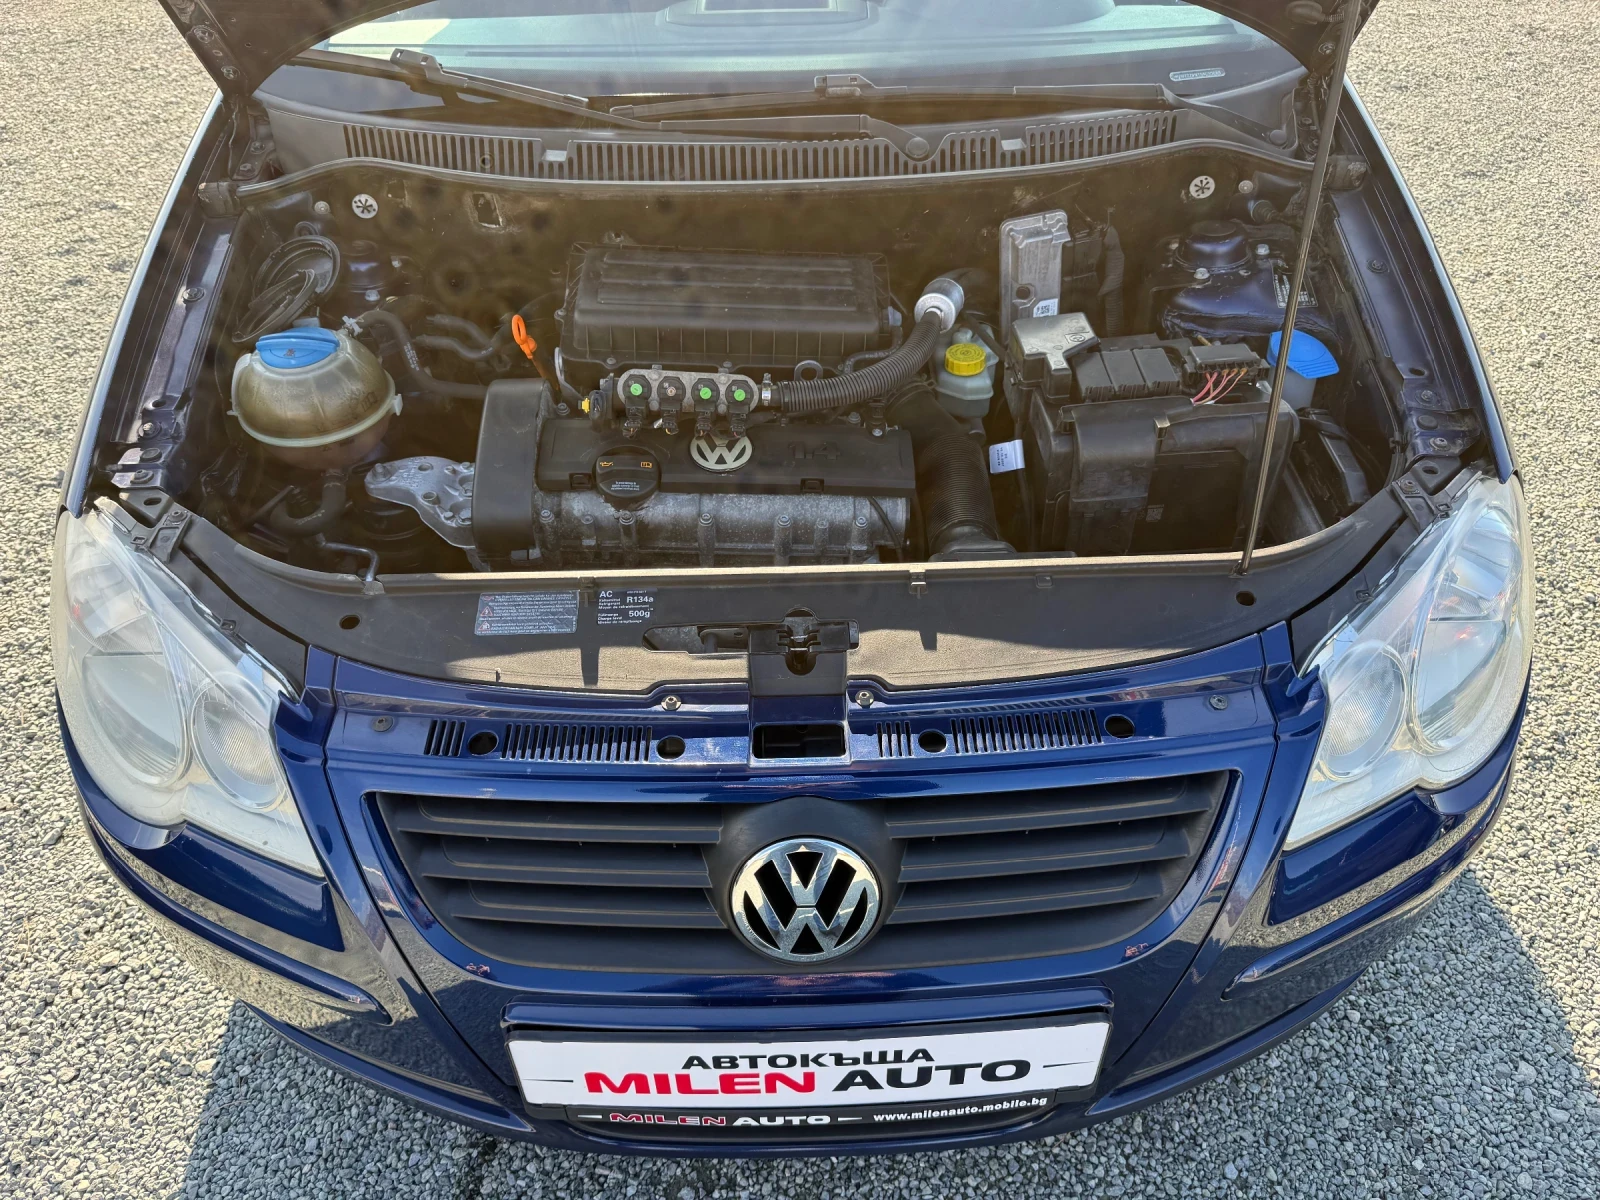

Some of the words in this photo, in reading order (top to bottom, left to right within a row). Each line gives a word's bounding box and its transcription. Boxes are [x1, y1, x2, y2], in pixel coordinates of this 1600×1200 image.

[788, 441, 841, 459] 1.4
[599, 590, 613, 598] AC
[628, 610, 651, 618] 500g
[584, 1071, 815, 1095] MILEN
[832, 1059, 1031, 1092] AUTO
[873, 1096, 1048, 1122] www.milenauto.mobile.bg
[609, 1112, 727, 1126] MILEN
[732, 1115, 831, 1126] AUTO
